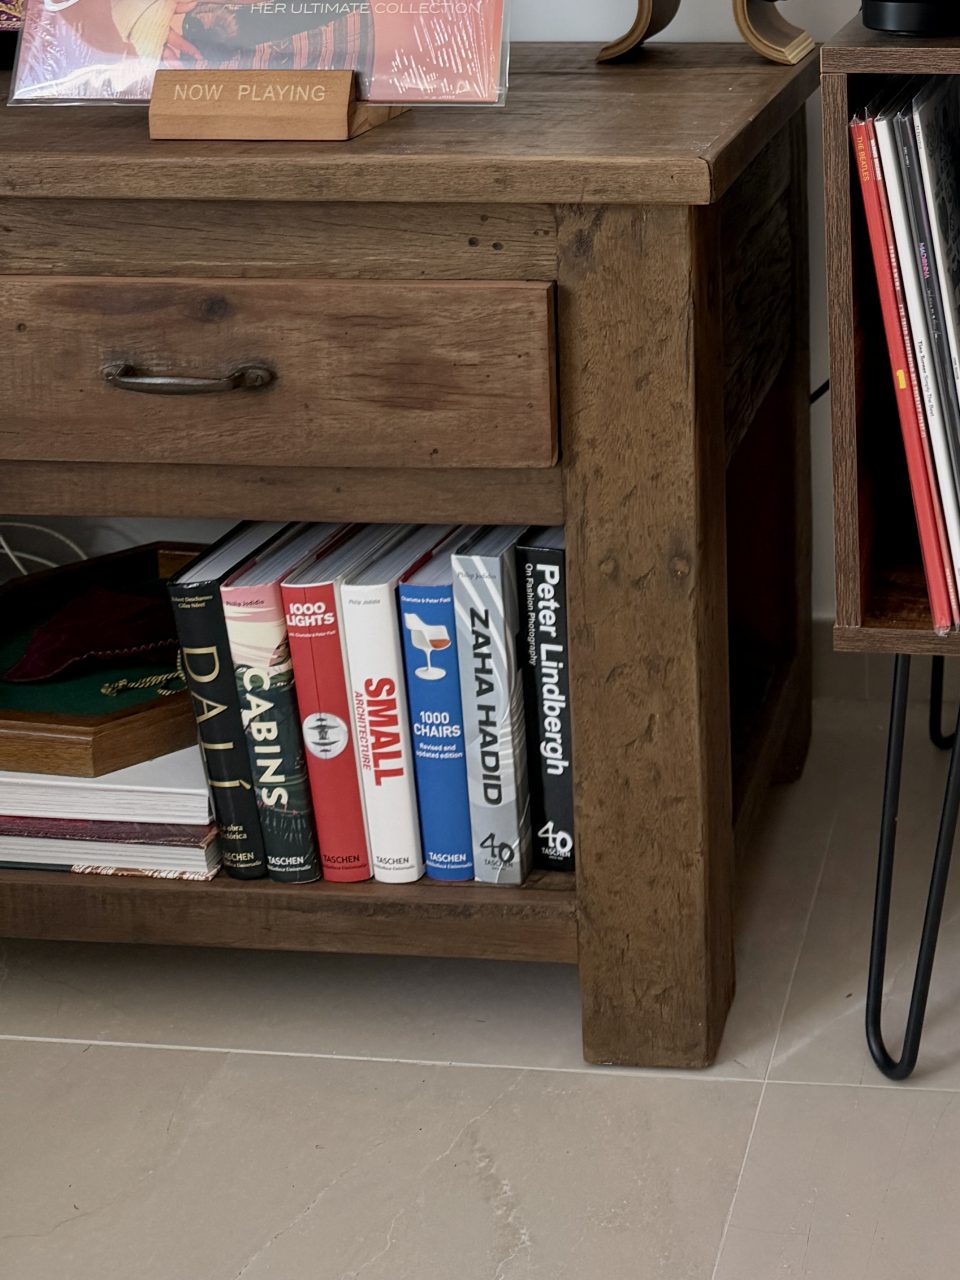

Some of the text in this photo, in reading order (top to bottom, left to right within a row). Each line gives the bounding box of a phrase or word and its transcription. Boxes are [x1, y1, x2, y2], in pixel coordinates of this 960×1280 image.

[250, 2, 481, 14] HER ULTIMATE COLLECTION
[173, 84, 326, 102] NOW PLAYING
[855, 136, 869, 181] THE BEATLES
[289, 602, 326, 614] 1000
[525, 563, 537, 666] On Fashion Photography
[286, 613, 335, 627] LIGHTS
[536, 563, 569, 775] Peter Lindbergh
[470, 607, 503, 805] ZAHA HADID
[183, 646, 251, 790] DALÍ
[419, 711, 450, 724] 1000
[243, 667, 289, 806] CABINS
[354, 691, 371, 771] ARCHITECTURE
[364, 677, 404, 786] SMALL
[413, 723, 461, 737] CHAIRS
[419, 742, 456, 751] Revised and
[415, 751, 463, 760] updated edition
[537, 821, 573, 852] 40
[480, 832, 515, 863] 40
[268, 856, 304, 866] TASCHEN
[323, 854, 360, 864] TASCHEN
[376, 856, 409, 865] TASCHEN
[428, 852, 467, 862] TASCHEN
